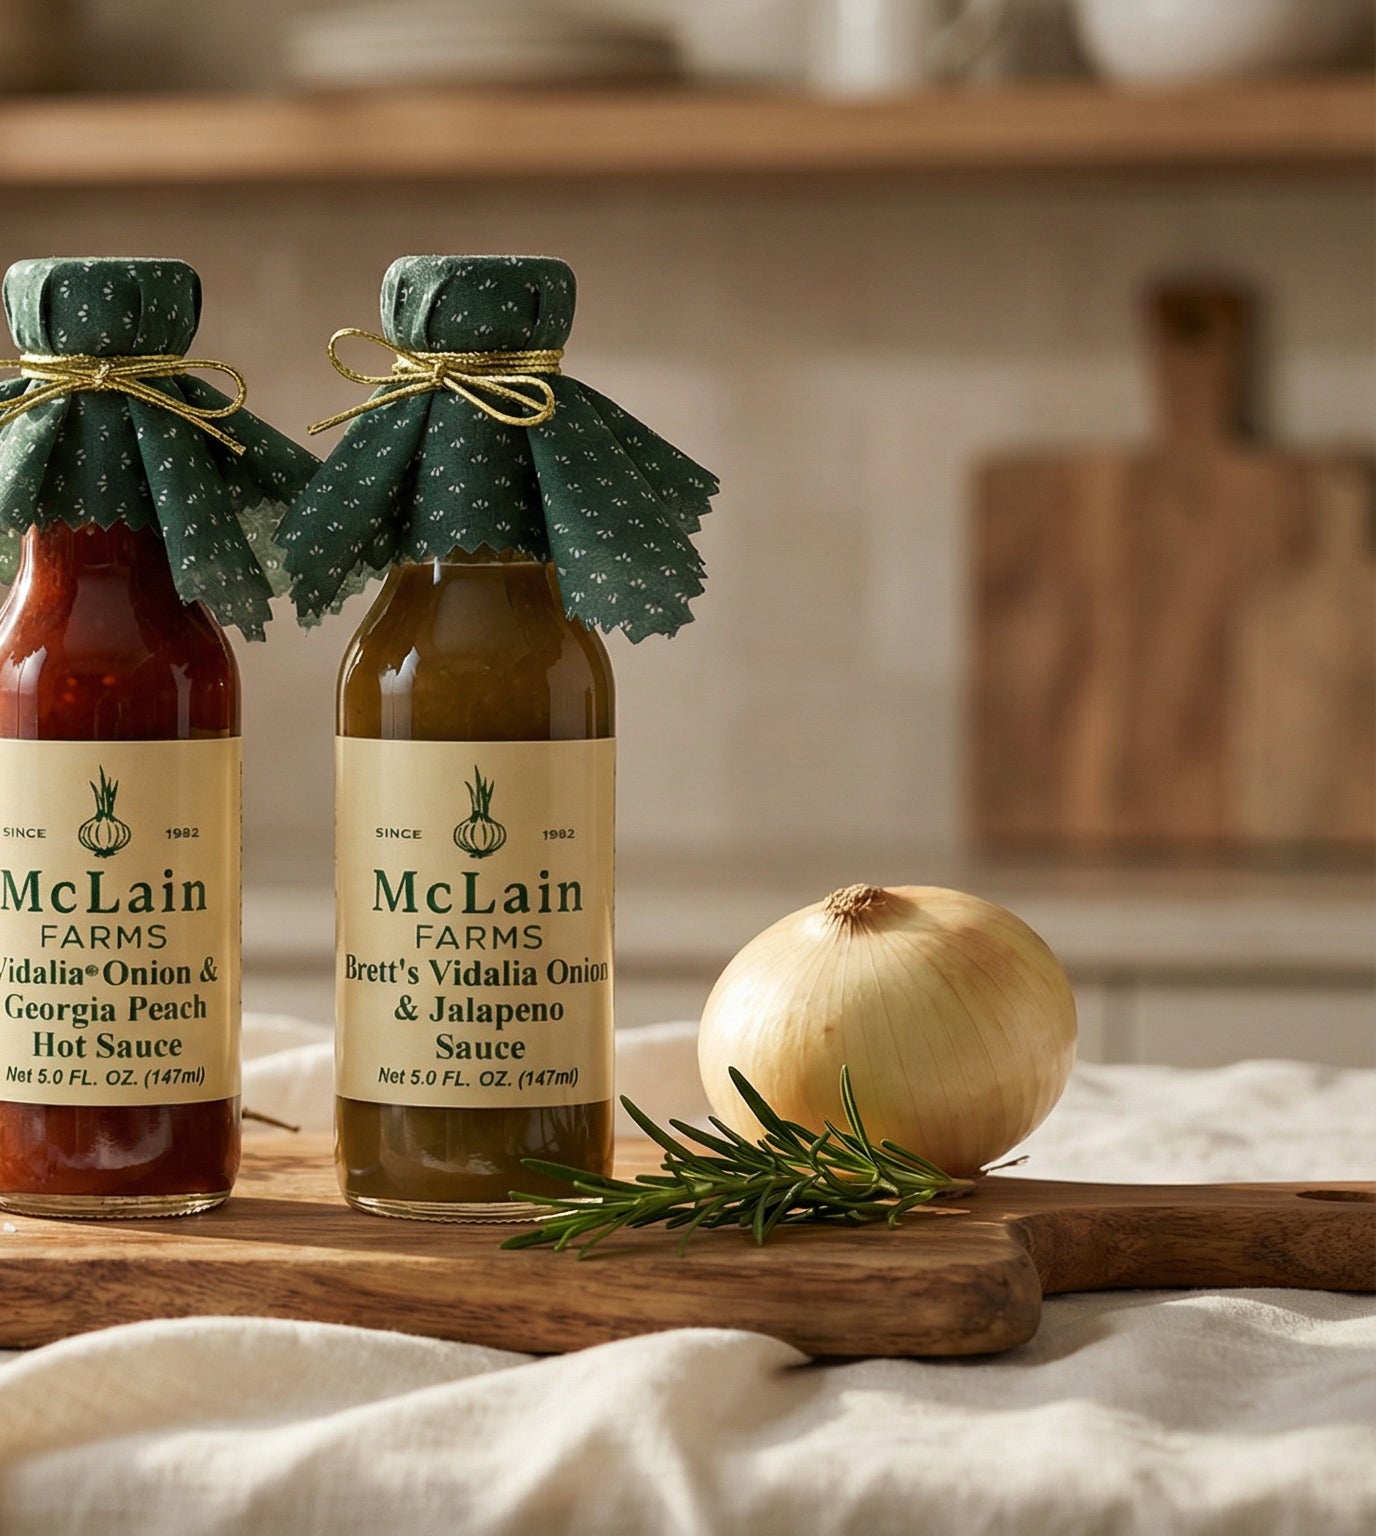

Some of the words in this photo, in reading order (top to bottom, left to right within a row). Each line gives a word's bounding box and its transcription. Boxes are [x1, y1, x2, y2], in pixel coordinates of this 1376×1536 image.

[3, 827, 46, 838] SINCE
[166, 827, 199, 839] 1982
[376, 828, 422, 839] SINCE
[543, 829, 575, 840] 1982
[1, 869, 207, 913] McLain
[373, 869, 582, 914] McLain
[41, 925, 167, 949] FARMS
[416, 925, 543, 949] FARMS
[104, 960, 191, 985] Onion
[200, 956, 218, 982] &
[346, 954, 419, 984] Brett's
[429, 959, 537, 986] Vidalia
[547, 957, 608, 985] Onion
[5, 994, 116, 1028] Georgia
[128, 994, 207, 1021] Peach
[395, 995, 418, 1021] &
[429, 996, 564, 1030] Jalapeno
[33, 1031, 87, 1058] Hot
[97, 1033, 182, 1059] Sauce
[436, 1034, 525, 1059] Sauce
[6, 1066, 33, 1083] Net
[38, 1070, 63, 1085] 5.0
[69, 1070, 97, 1085] FL.
[106, 1070, 138, 1086] OZ.
[144, 1066, 205, 1089] (147ml)
[378, 1067, 405, 1084] Net
[410, 1070, 436, 1085] 5.0
[442, 1071, 470, 1087] FL.
[479, 1071, 512, 1087] OZ.
[519, 1067, 578, 1089] (147ml)
